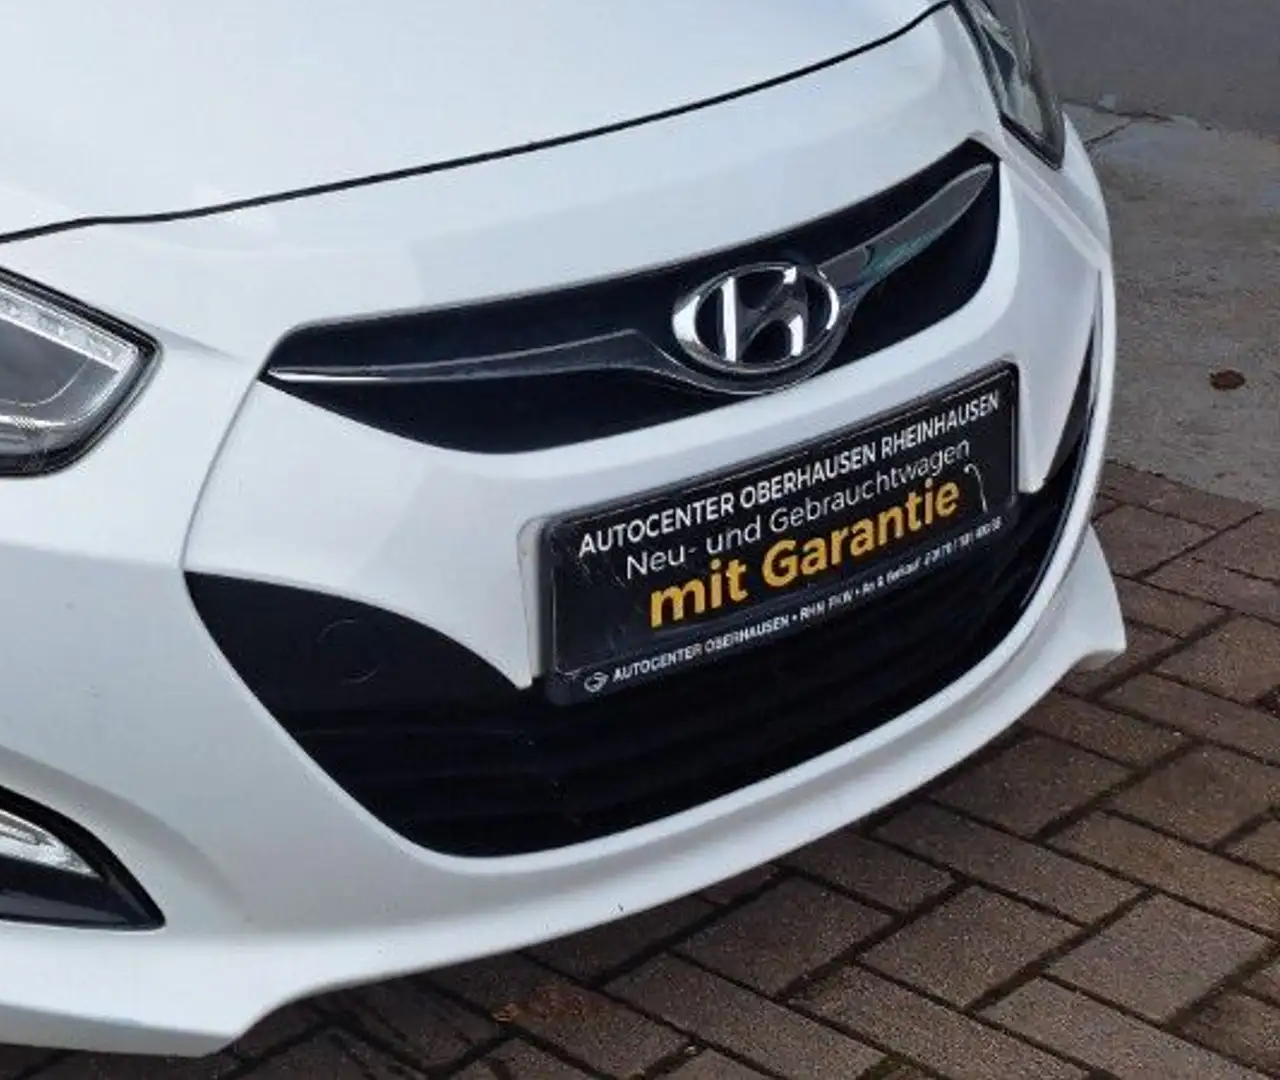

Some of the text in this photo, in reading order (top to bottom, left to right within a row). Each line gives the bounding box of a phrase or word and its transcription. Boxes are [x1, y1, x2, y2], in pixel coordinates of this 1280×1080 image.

[579, 390, 1000, 558] AUTOCENTER OBERHAUSEN RHEINHAUSEN
[627, 439, 970, 580] Neu- und Gebrauchtwagen
[650, 558, 748, 629] mit
[762, 478, 960, 587] Garantie
